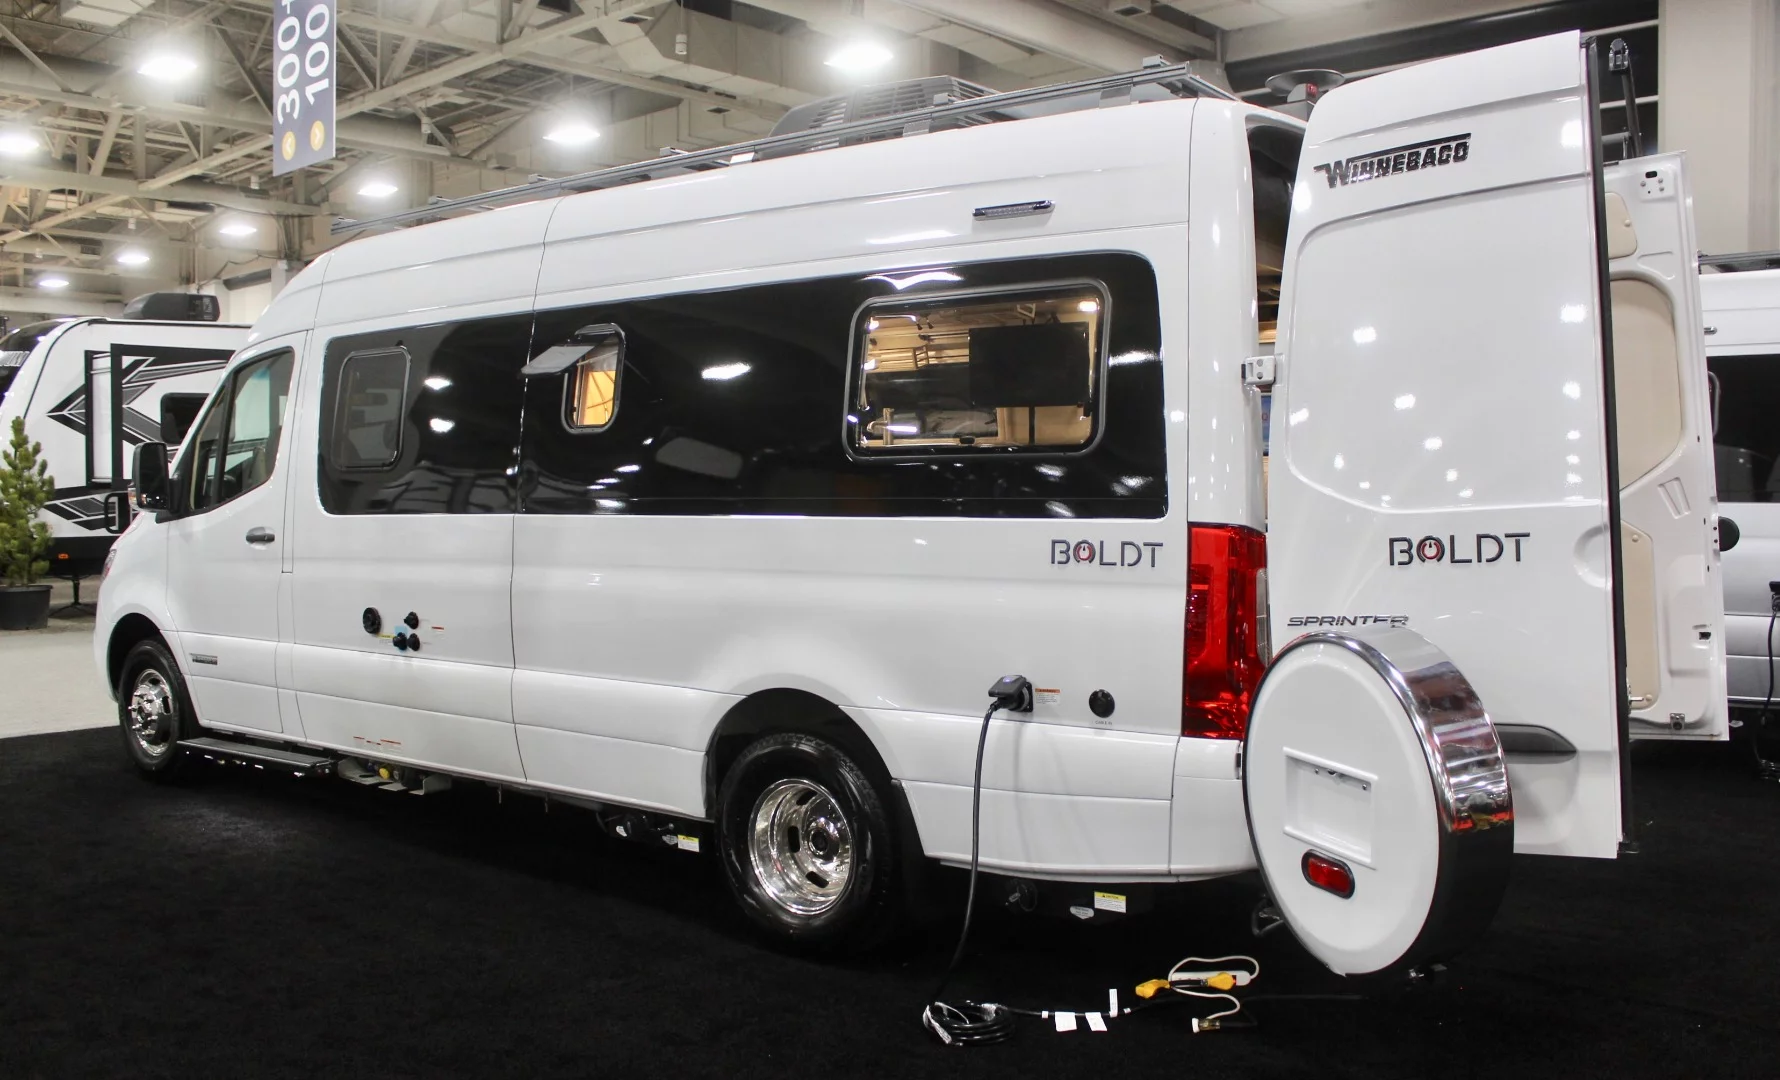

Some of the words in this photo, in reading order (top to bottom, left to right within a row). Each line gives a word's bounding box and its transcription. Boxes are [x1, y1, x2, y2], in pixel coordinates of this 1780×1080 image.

[305, 4, 329, 105] 100
[1313, 132, 1472, 189] WINNEBAGO
[1050, 539, 1164, 568] BOLDT
[1388, 532, 1531, 566] BOLDT
